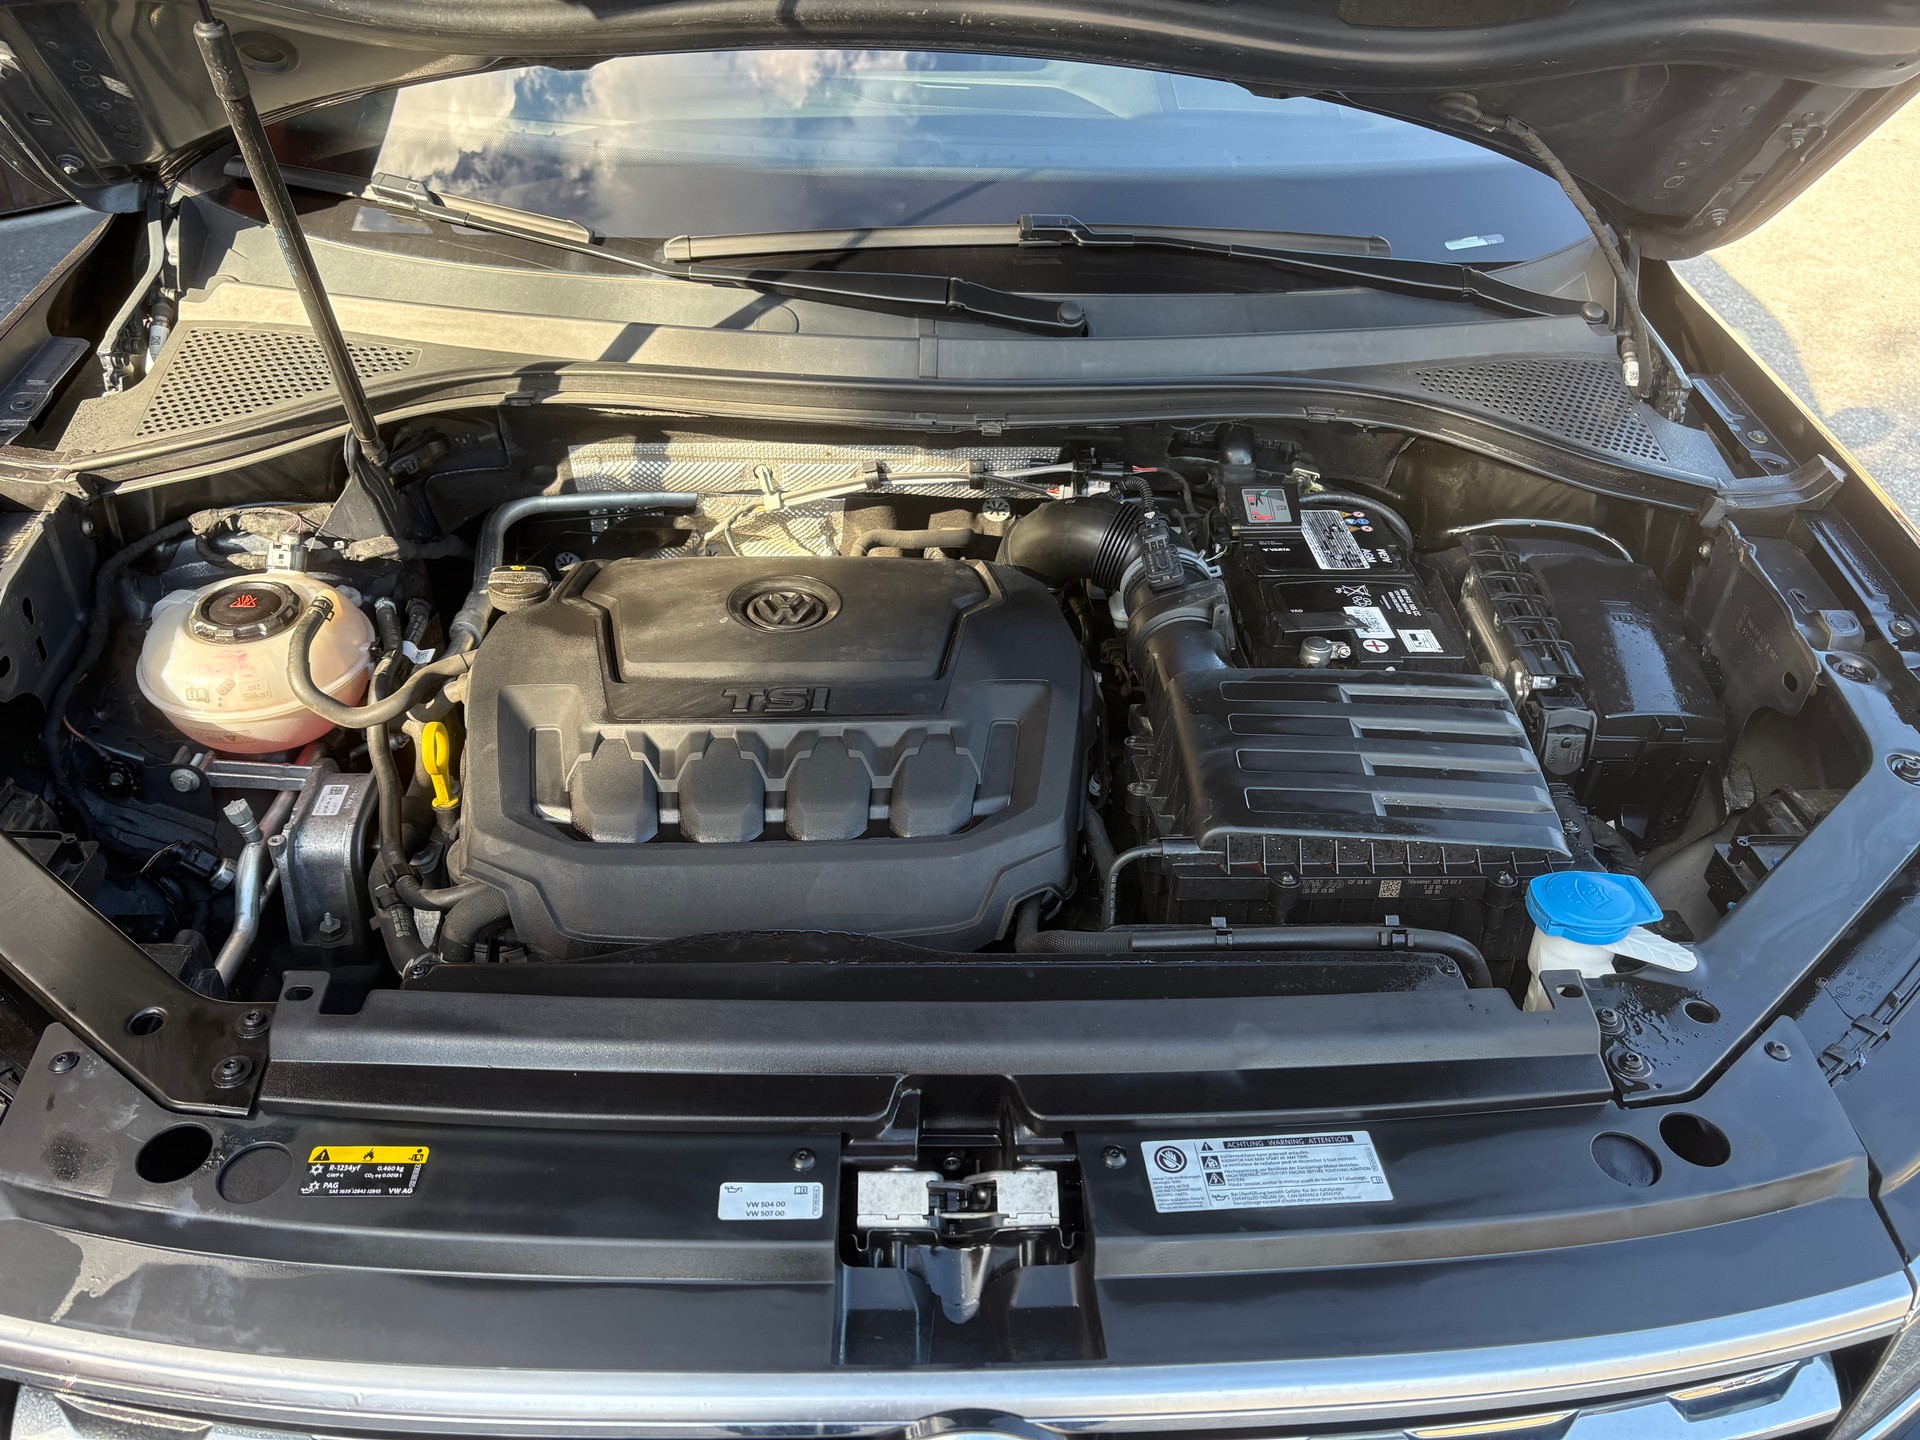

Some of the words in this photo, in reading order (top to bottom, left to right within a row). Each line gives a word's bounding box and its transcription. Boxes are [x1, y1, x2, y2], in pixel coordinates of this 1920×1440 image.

[248, 684, 261, 692] mit
[243, 691, 270, 700] Silikat
[723, 686, 830, 713] TSI
[1302, 879, 1324, 889] VW
[1325, 879, 1345, 889] AG
[1227, 1140, 1263, 1148] ACHTUNG
[1267, 1138, 1304, 1146] WARNING
[1308, 1136, 1348, 1144] ATTENTION
[329, 1164, 361, 1173] R-1234yf
[396, 1165, 405, 1173] kg
[323, 1181, 339, 1189] PAG
[388, 1187, 401, 1195] VW
[401, 1187, 413, 1195] AG
